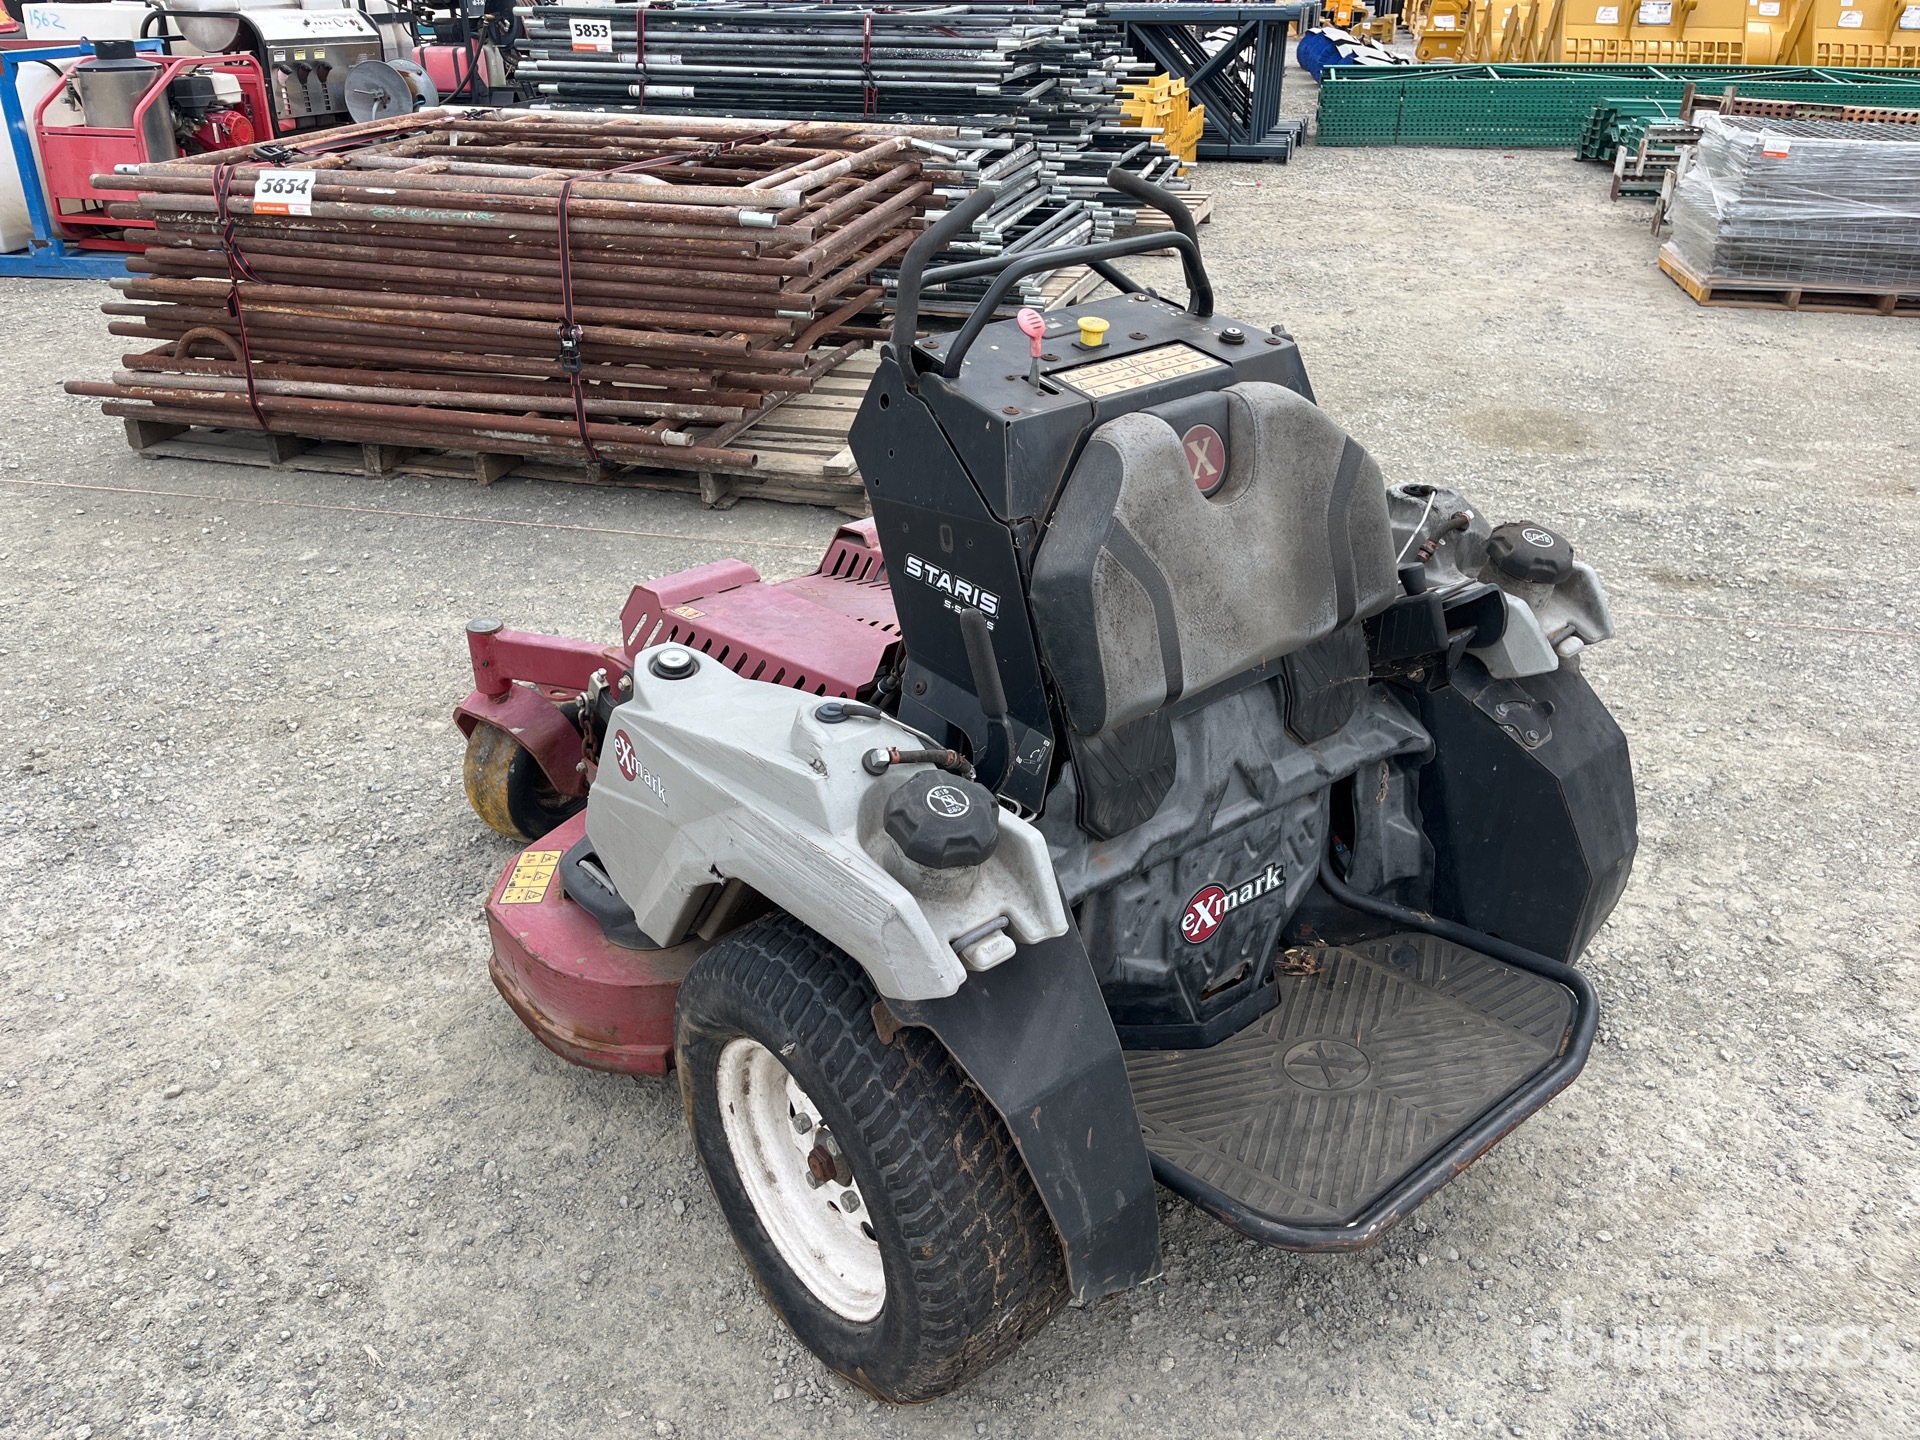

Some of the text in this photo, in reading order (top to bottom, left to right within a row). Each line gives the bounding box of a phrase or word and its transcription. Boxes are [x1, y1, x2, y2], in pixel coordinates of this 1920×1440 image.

[28, 9, 66, 30] 1562
[574, 23, 609, 38] 5853
[261, 178, 310, 195] 5854
[905, 555, 999, 616] STARIS
[614, 734, 668, 804] eXmark
[1181, 864, 1283, 937] eXmark
